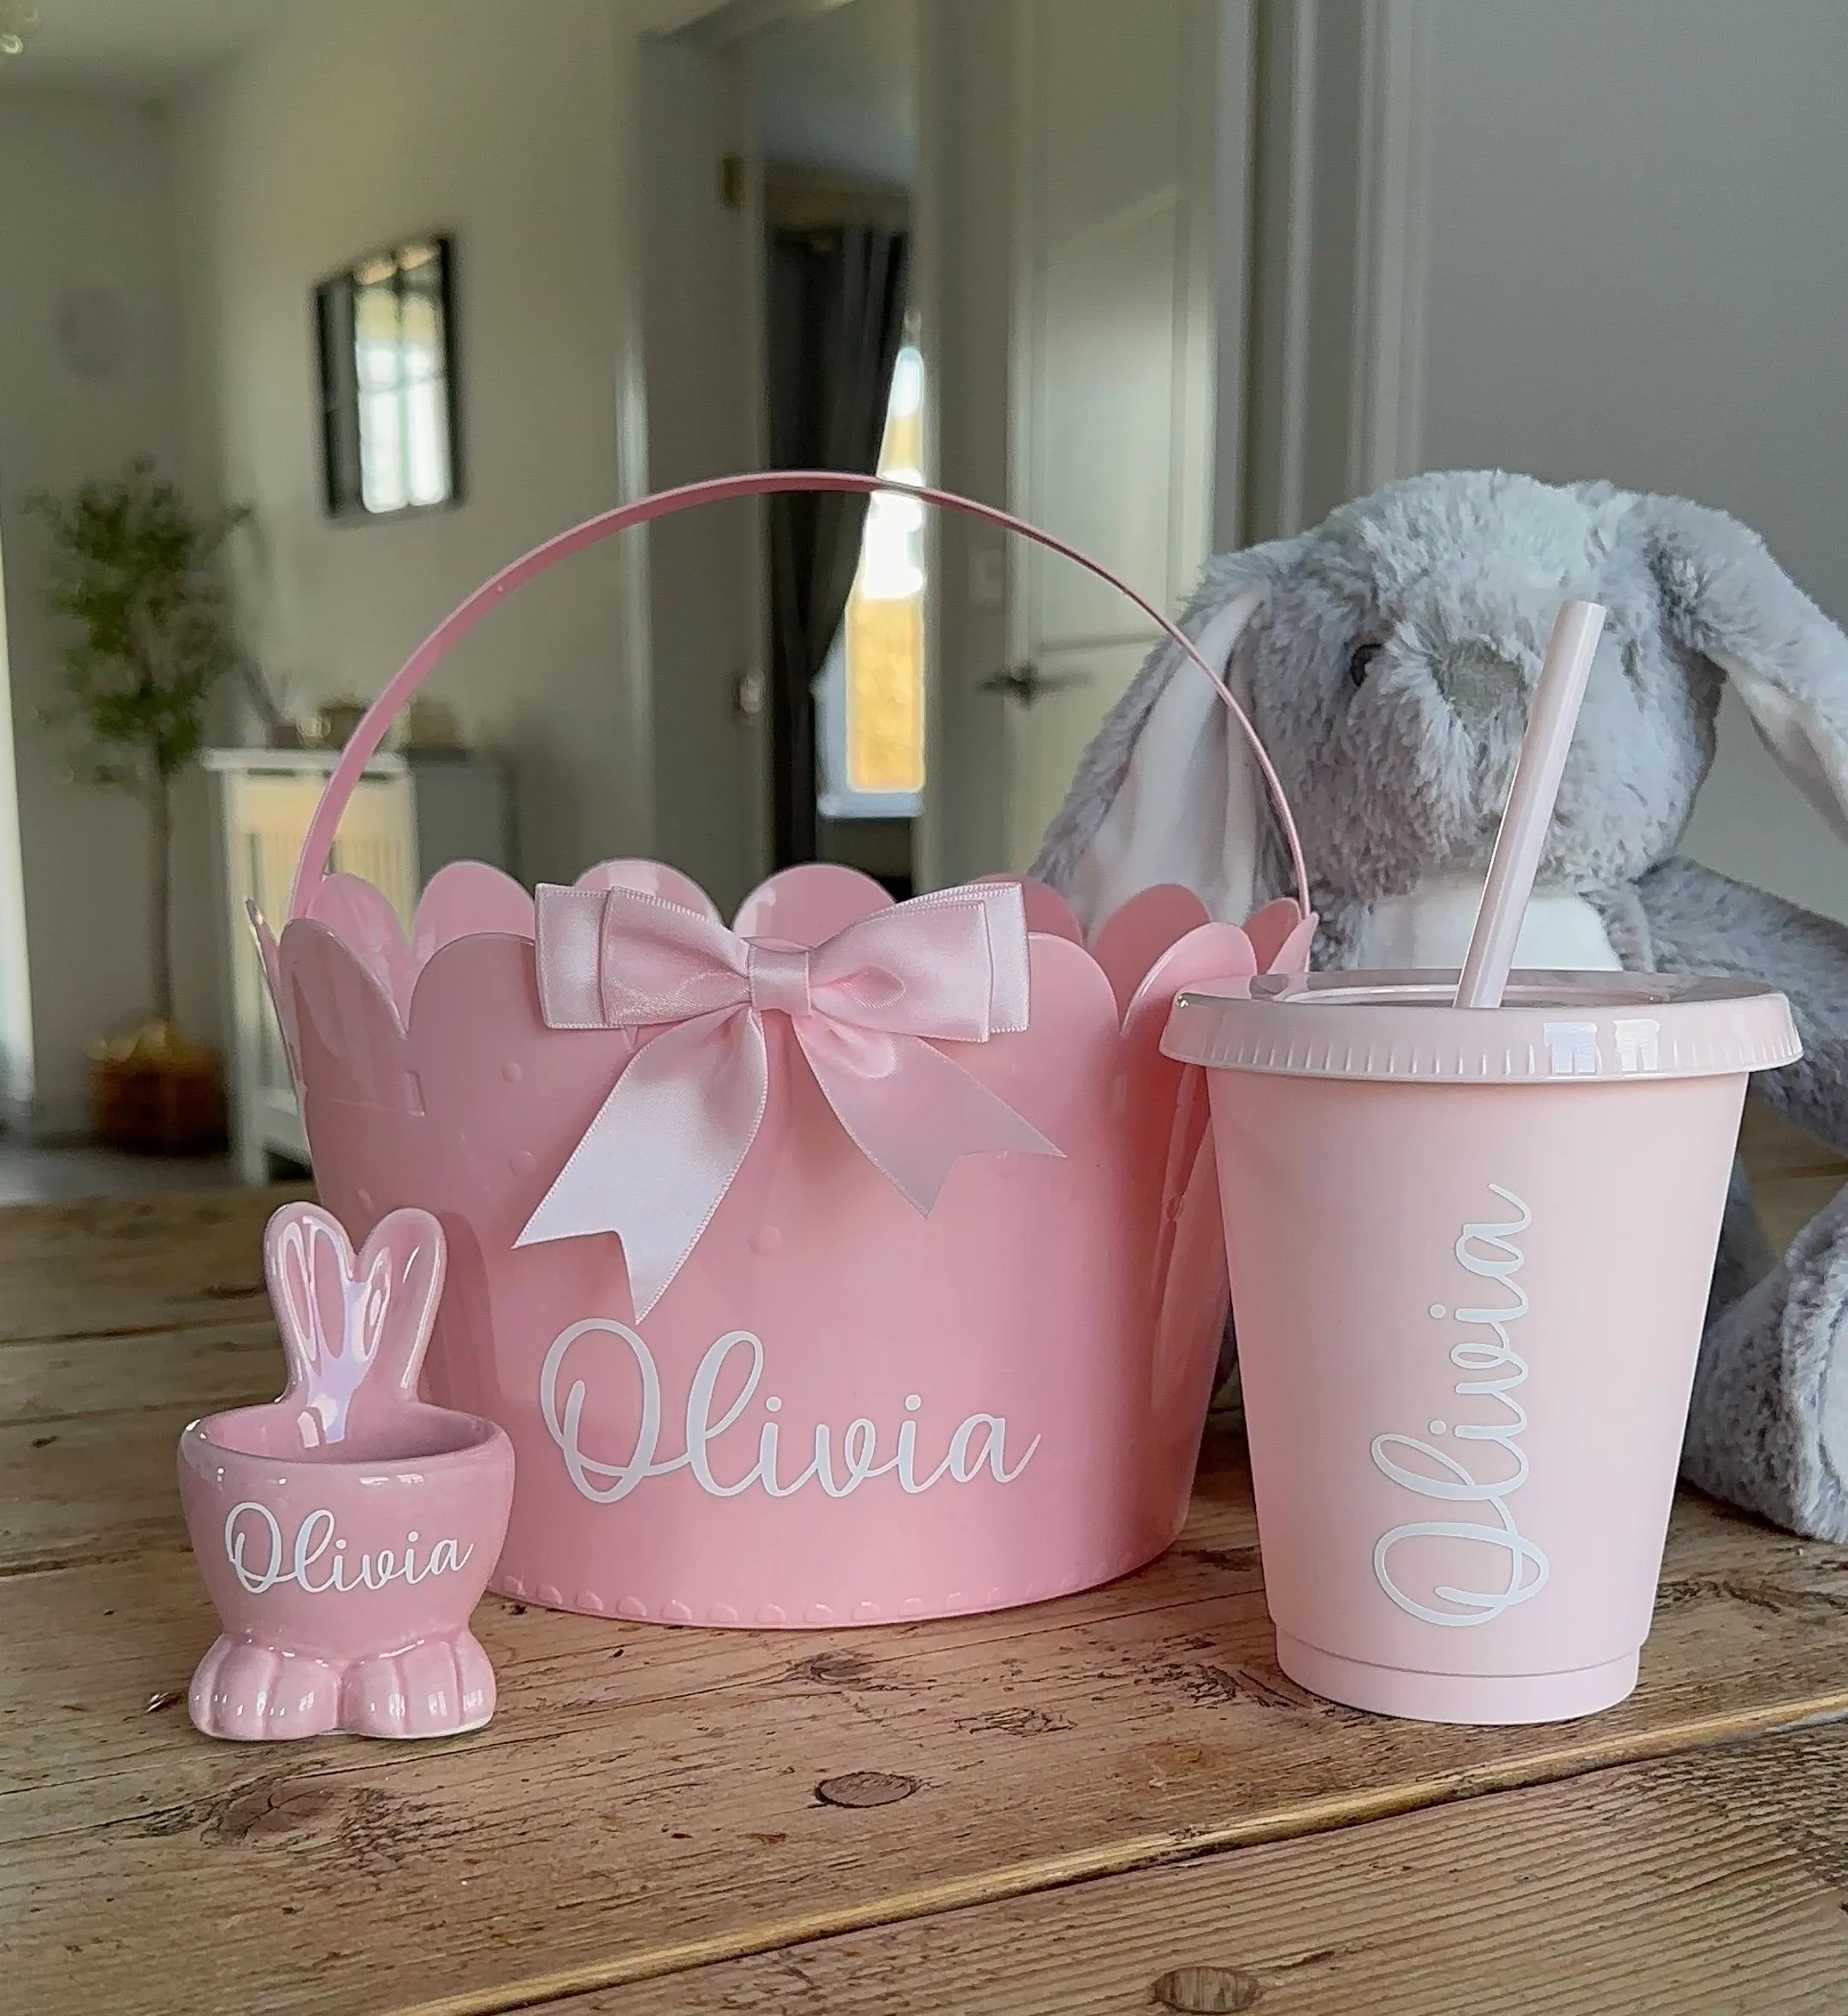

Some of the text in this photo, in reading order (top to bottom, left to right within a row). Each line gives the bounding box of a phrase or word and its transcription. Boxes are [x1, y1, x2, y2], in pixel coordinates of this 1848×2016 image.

[539, 1318, 1042, 1504] Olivia
[1370, 1183, 1550, 1628] Olivia
[224, 1501, 475, 1594] Olivia
